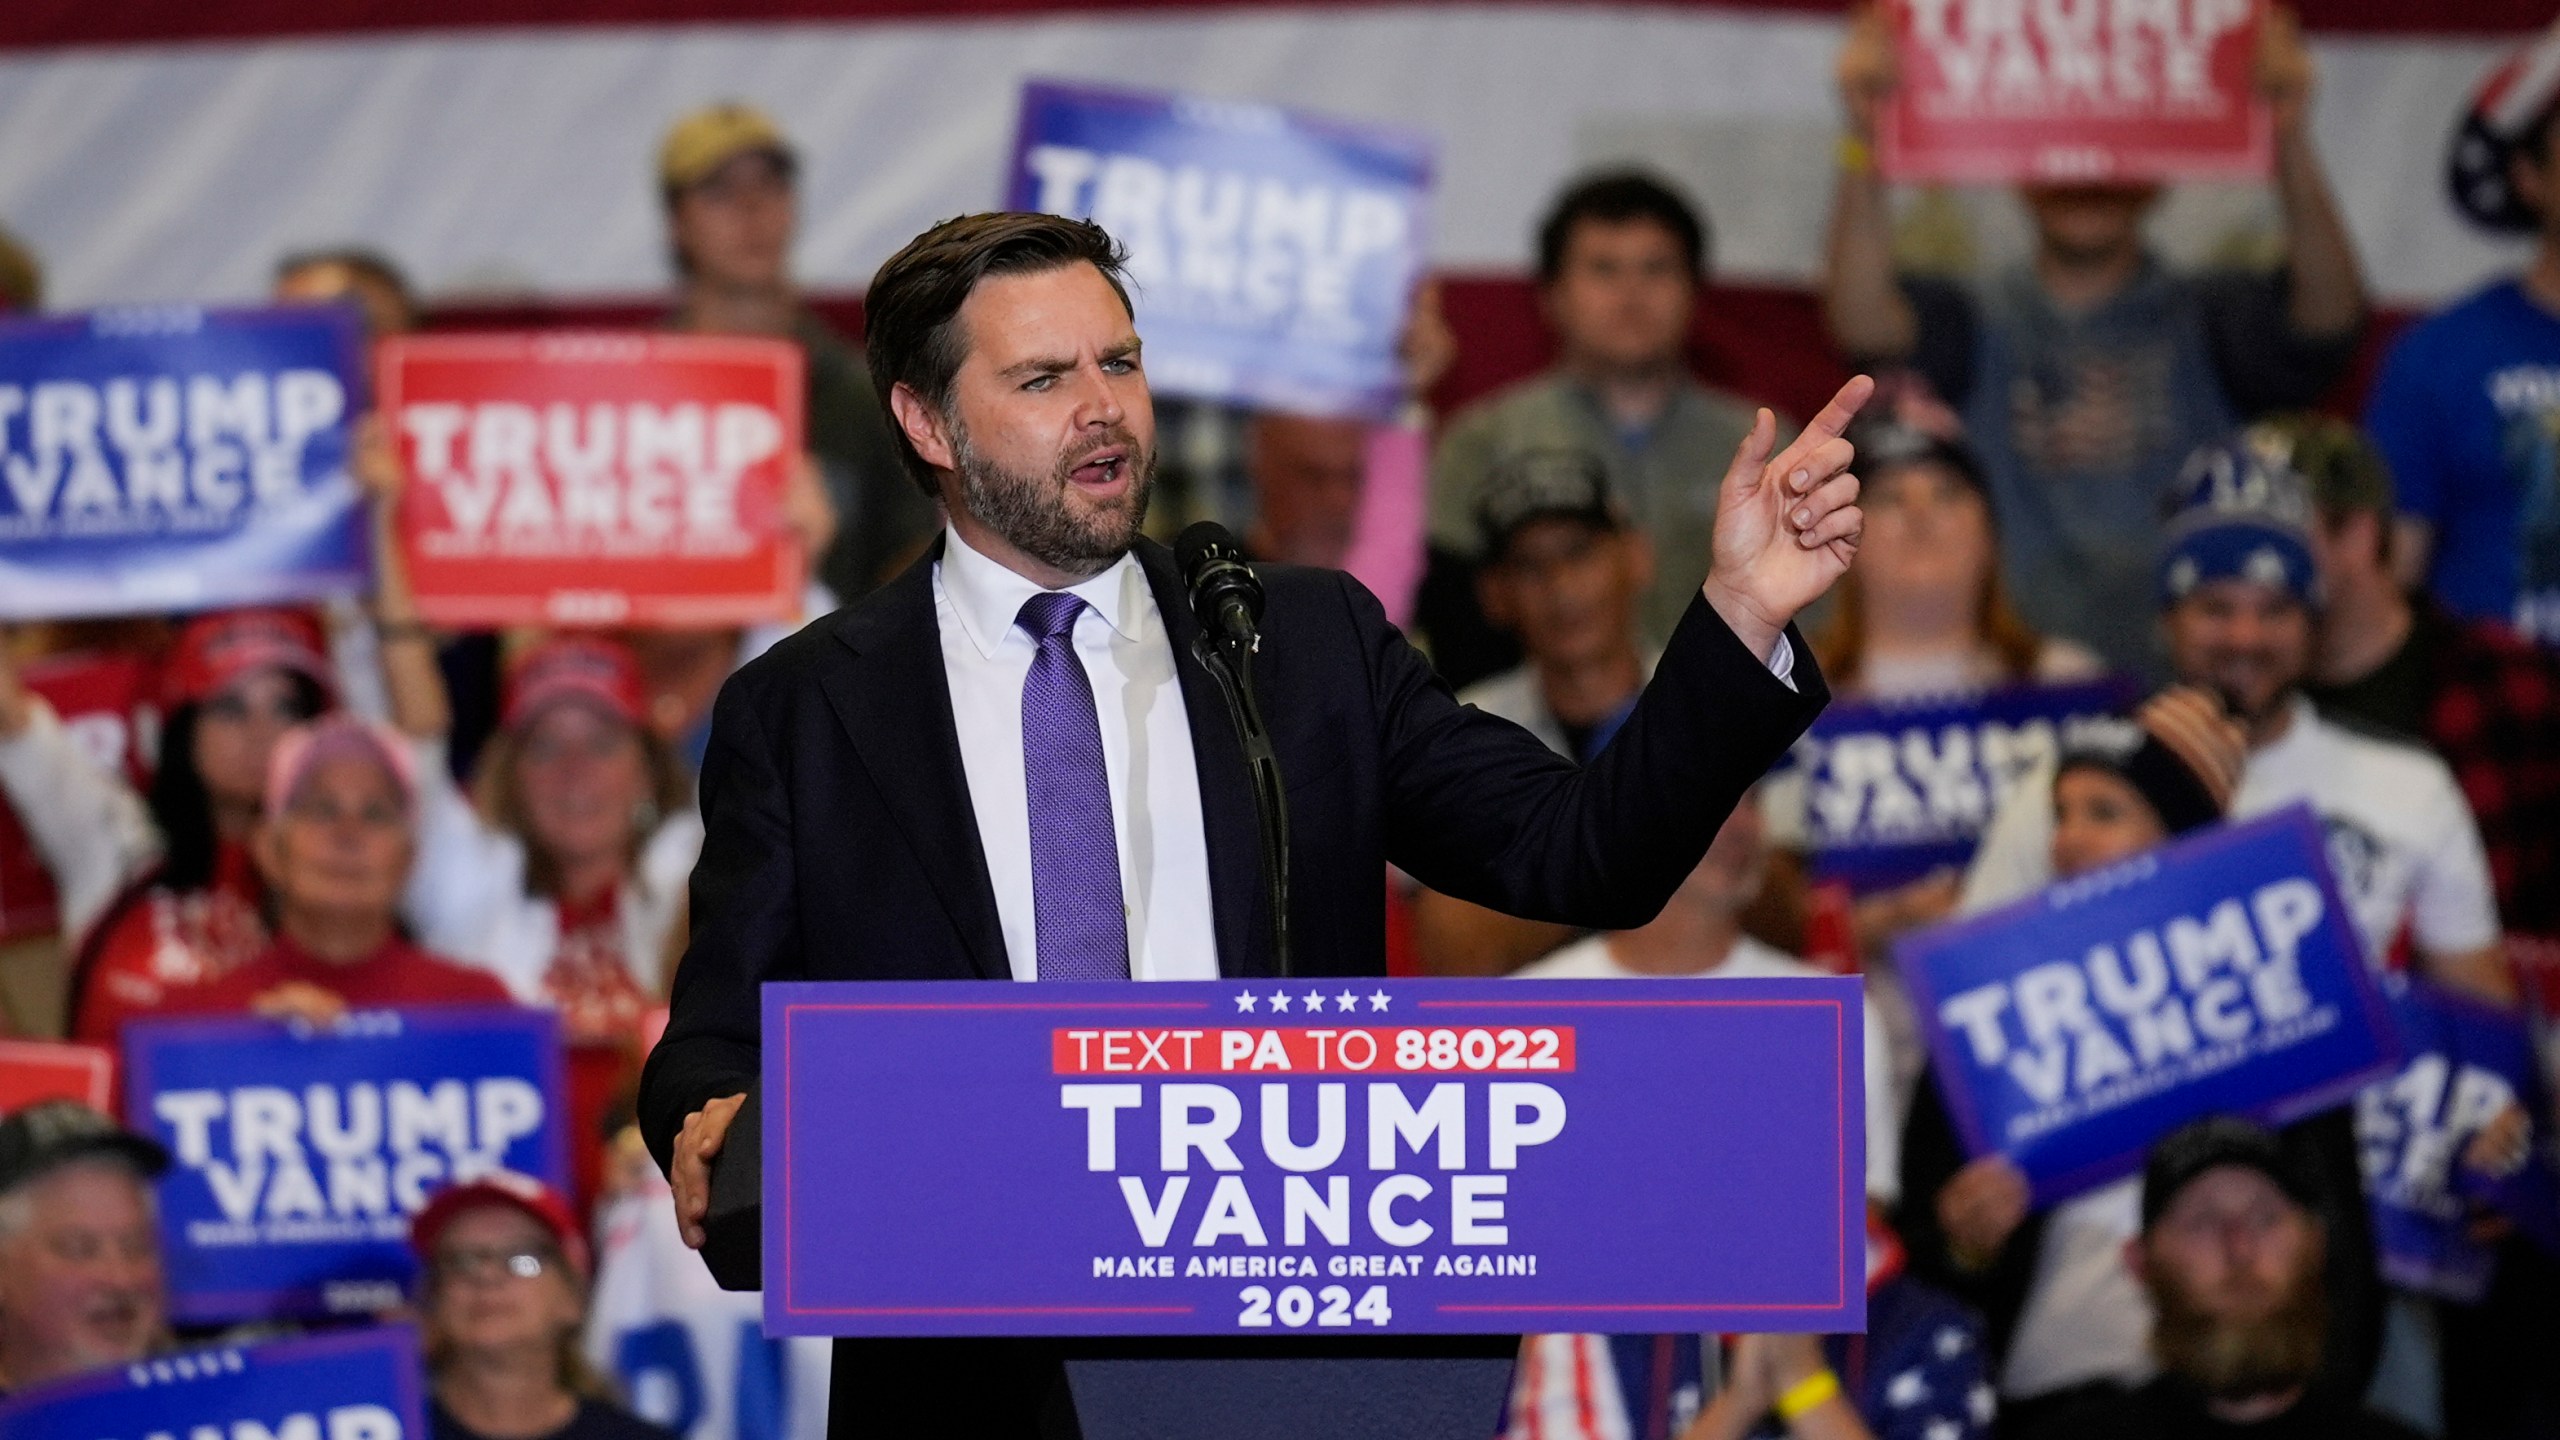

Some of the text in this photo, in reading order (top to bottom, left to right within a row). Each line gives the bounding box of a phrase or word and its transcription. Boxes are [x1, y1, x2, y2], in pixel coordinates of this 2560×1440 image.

[1934, 36, 2214, 98] VANCE
[1031, 146, 1406, 254] TRUMP
[1114, 220, 1350, 312] ANCE
[3, 440, 300, 514] VANCE
[402, 402, 783, 482] TRUMP
[440, 462, 738, 532] VANCE
[1940, 877, 2325, 1067] TRUMP
[1068, 1028, 1560, 1072] TEXT PA TO 88022
[2006, 956, 2310, 1103] VANCE
[154, 1077, 544, 1168] TRUMP
[1060, 1082, 1567, 1173] TRUMP
[1117, 1173, 1509, 1248] VANCE
[1092, 1254, 1537, 1279] MAKE AMERICA GREAT AGAIN!
[1238, 1284, 1392, 1328] 2024
